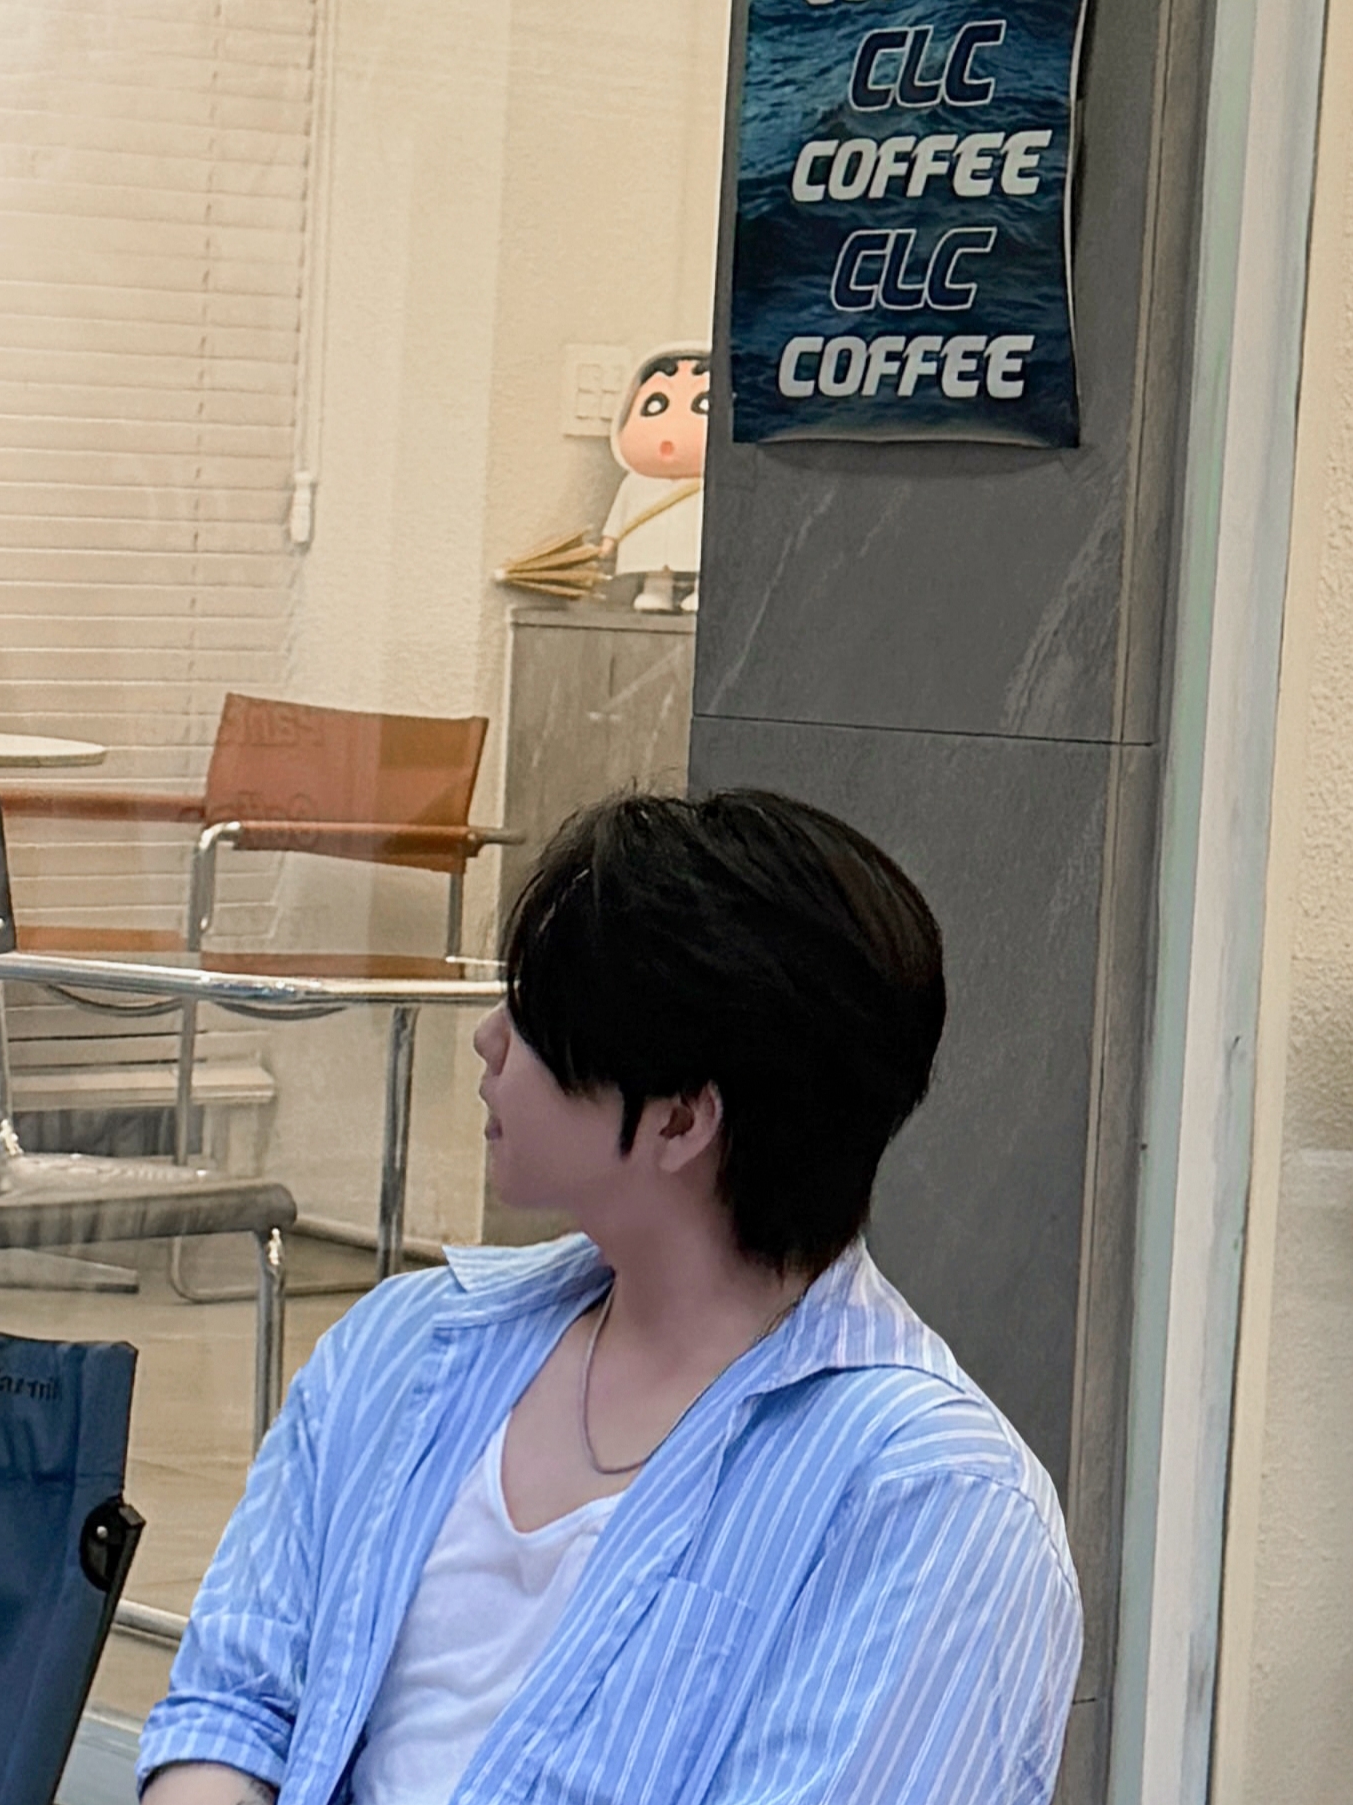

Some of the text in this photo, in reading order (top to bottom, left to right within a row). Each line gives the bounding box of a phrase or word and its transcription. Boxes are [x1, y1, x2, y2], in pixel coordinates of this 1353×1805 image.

[849, 20, 1006, 112] CLC
[792, 130, 1052, 202] COFFEE
[831, 227, 997, 311] CLC
[778, 335, 1035, 399] COFFEE
